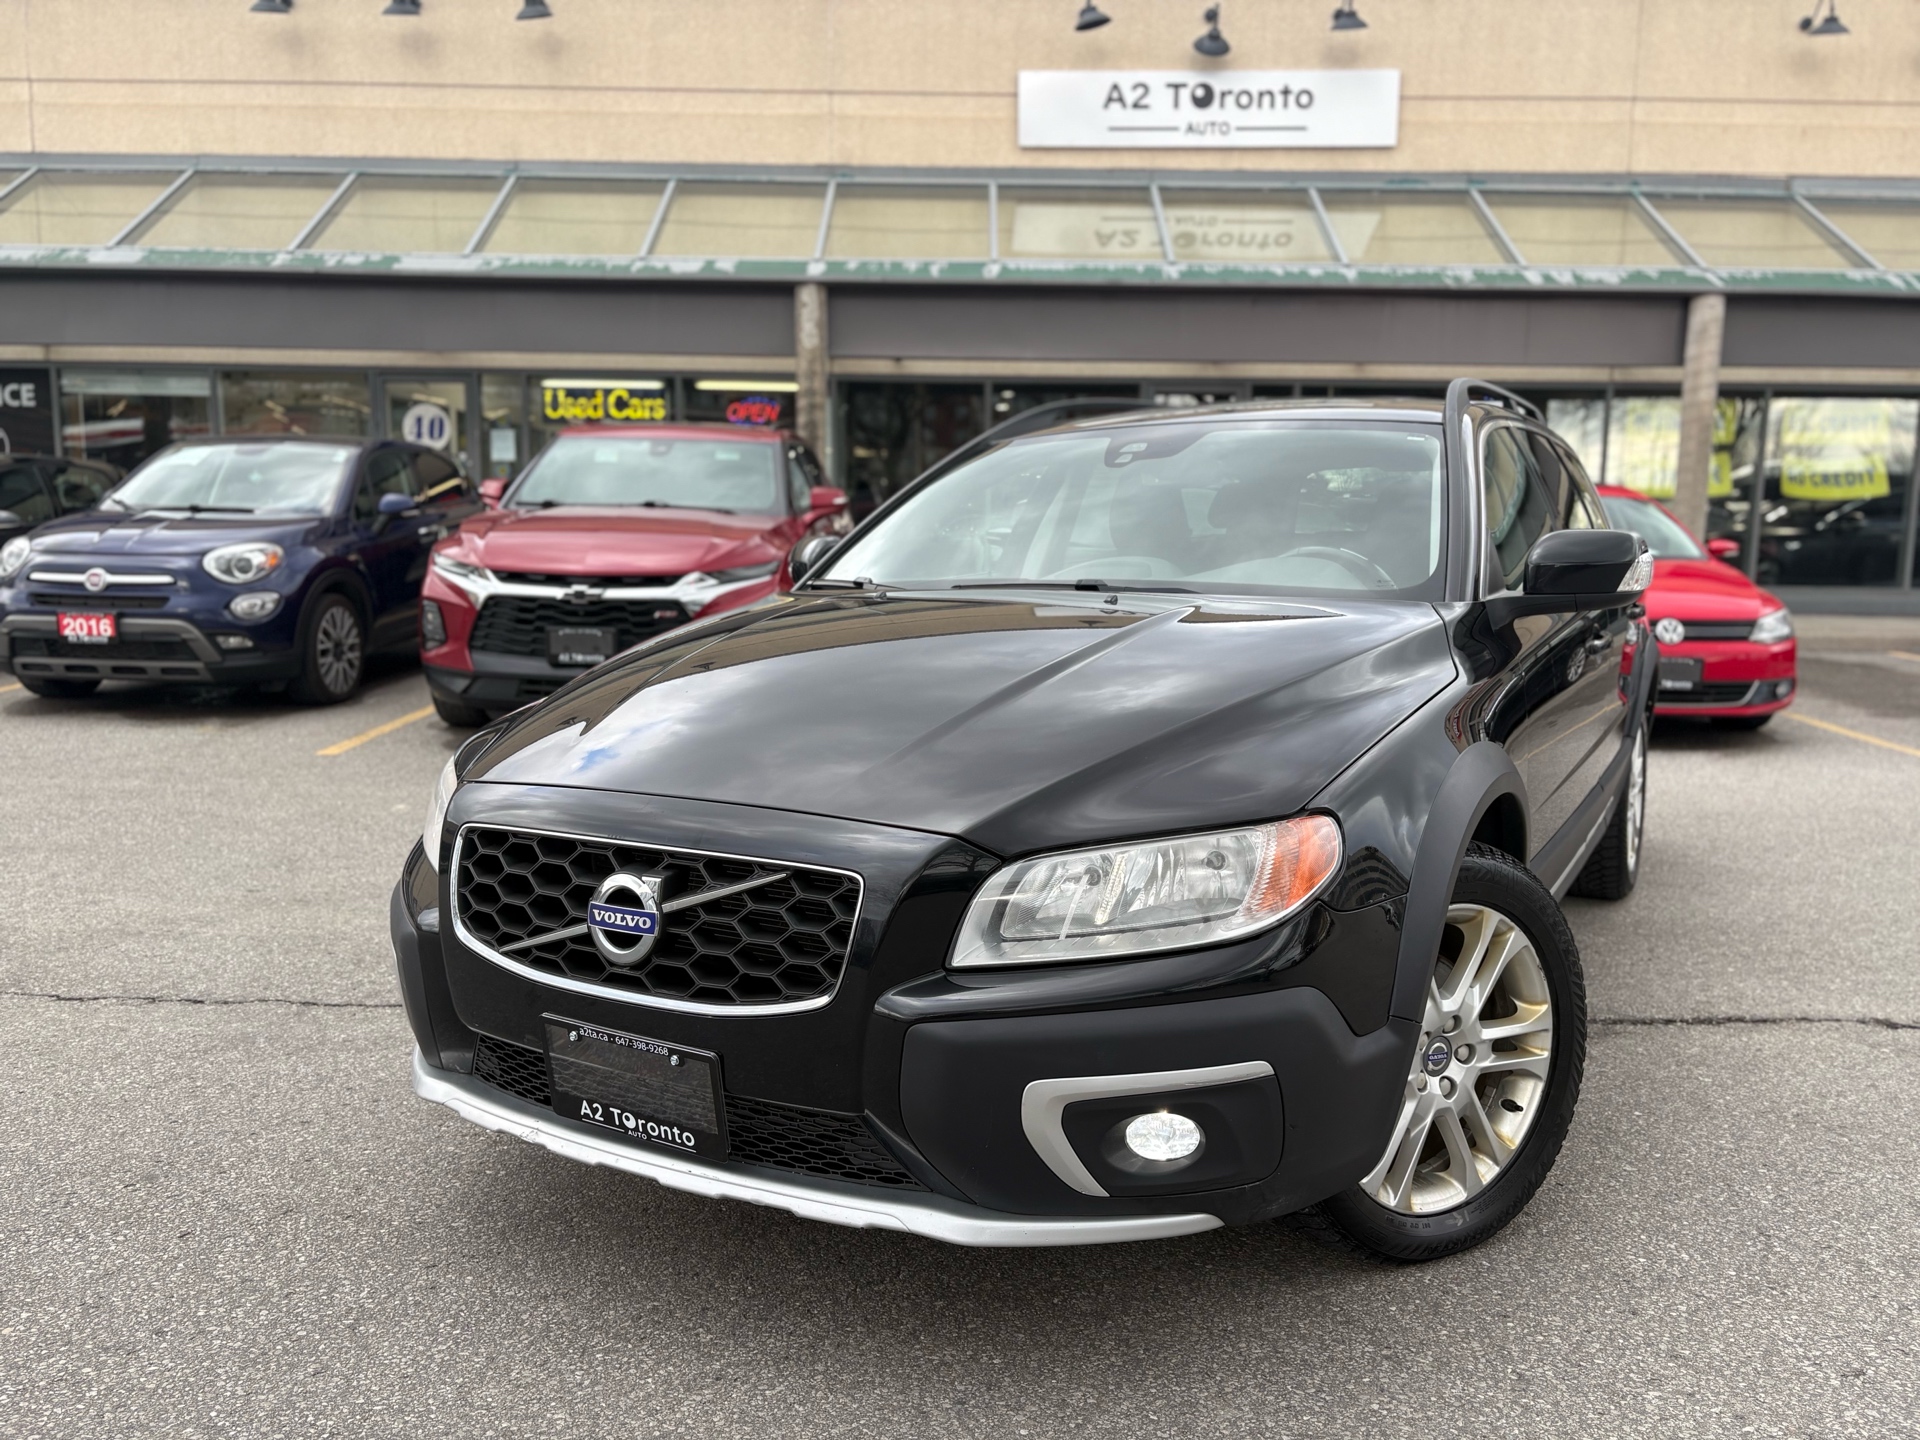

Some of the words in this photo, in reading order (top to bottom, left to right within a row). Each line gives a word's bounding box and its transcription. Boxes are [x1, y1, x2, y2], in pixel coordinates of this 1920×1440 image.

[1103, 83, 1150, 110] A2
[1165, 82, 1315, 110] Toronto
[1184, 121, 1231, 136] AUTO
[543, 388, 605, 419] Used
[607, 388, 666, 420] Cars
[726, 401, 781, 424] OPEN
[411, 414, 445, 441] 40
[1809, 470, 1876, 488] CREDIT
[62, 617, 113, 637] 2016
[593, 909, 651, 929] VOLVO
[579, 1027, 608, 1042] a2ta.ca
[615, 1036, 669, 1056] 647-398-9268
[580, 1100, 604, 1122] A2
[610, 1107, 695, 1147] Toronto
[628, 1130, 648, 1140] AUTO
